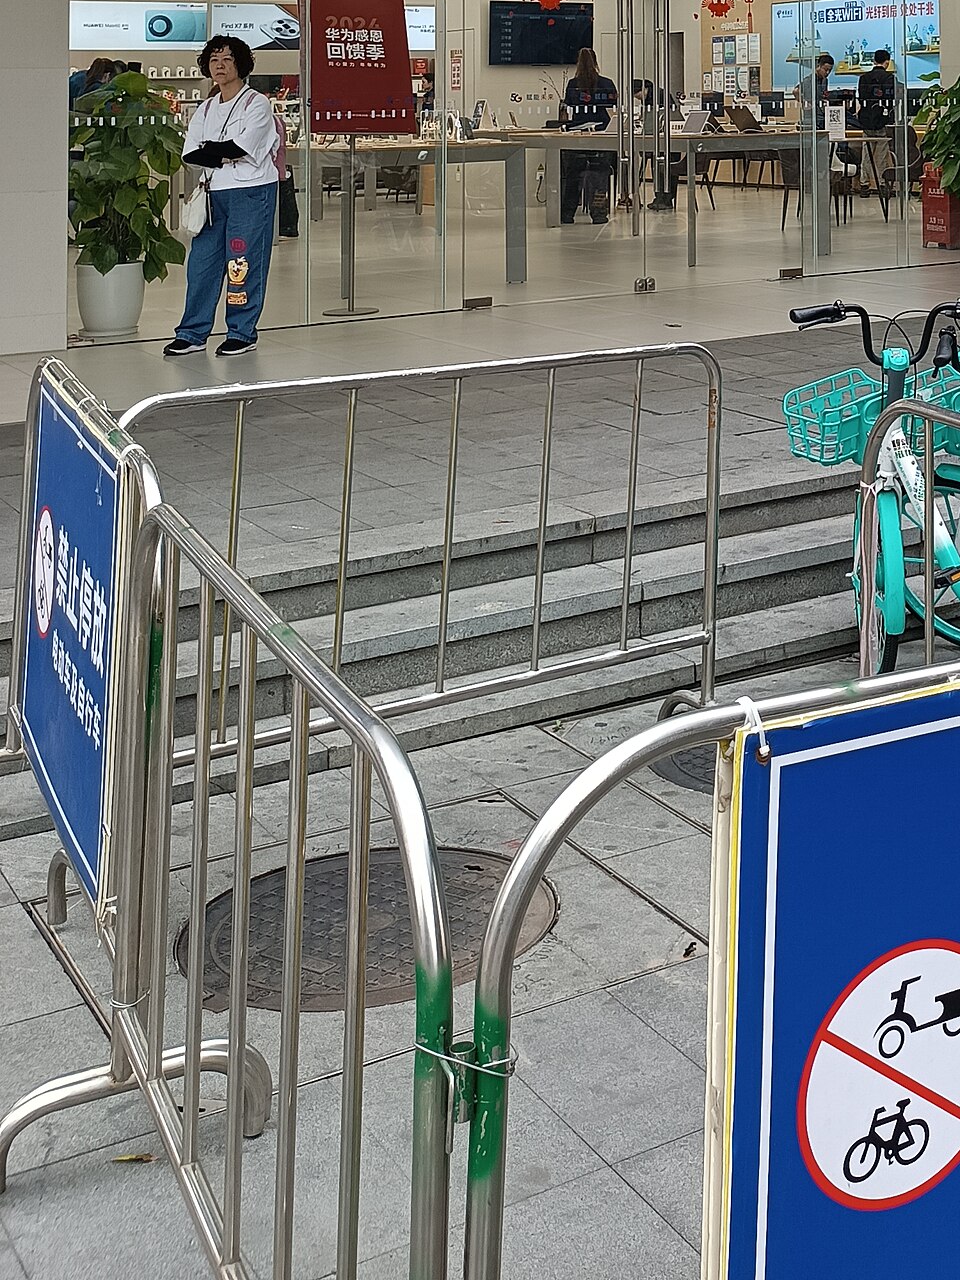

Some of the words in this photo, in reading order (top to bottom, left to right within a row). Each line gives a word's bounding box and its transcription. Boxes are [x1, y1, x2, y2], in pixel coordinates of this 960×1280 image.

[325, 27, 384, 43] 华为感恩
[326, 42, 386, 60] 回馈季
[56, 525, 107, 679] 禁止停放
[52, 628, 101, 751] 电动车及自行车
